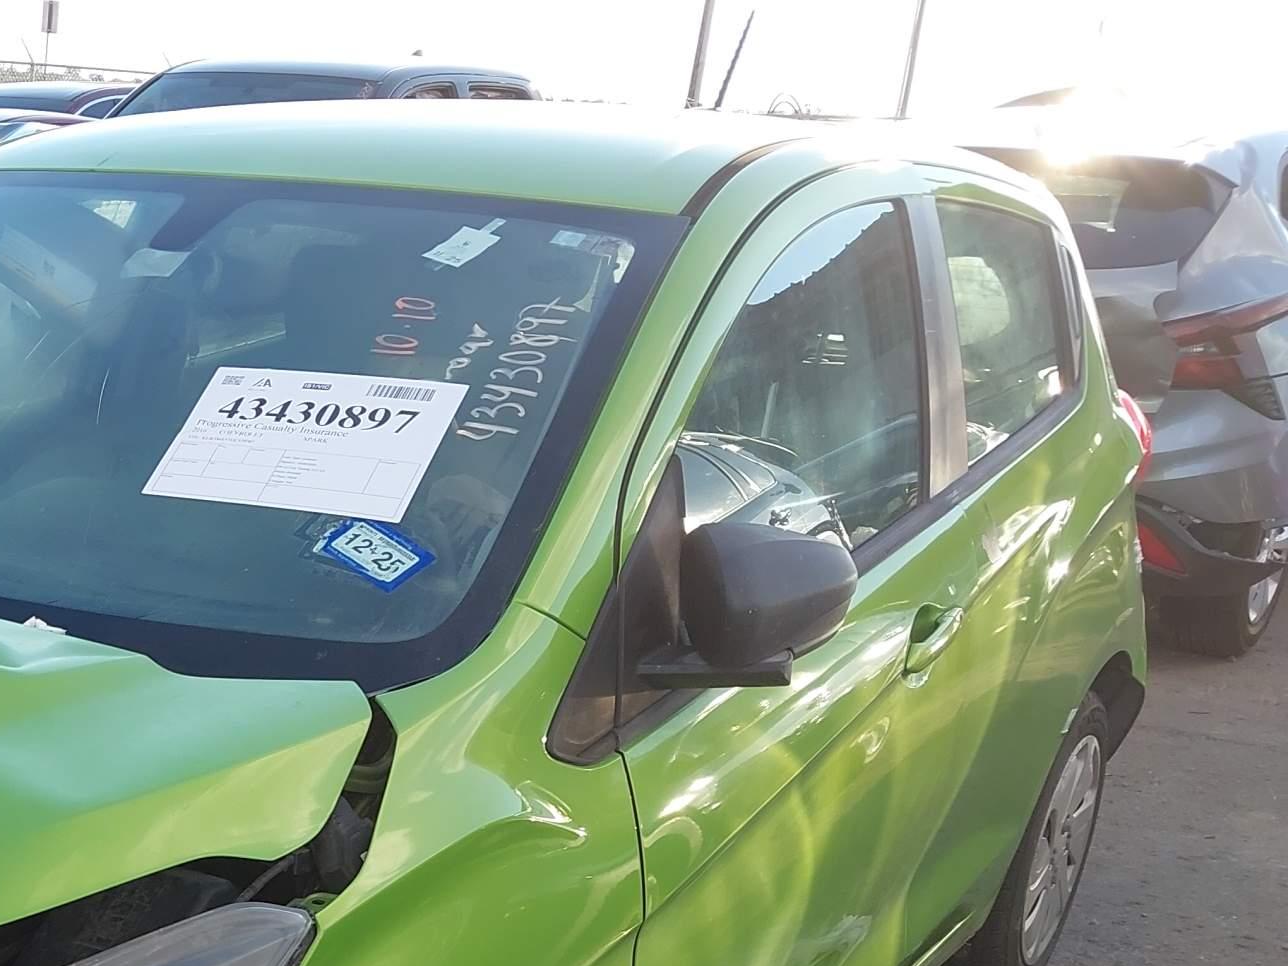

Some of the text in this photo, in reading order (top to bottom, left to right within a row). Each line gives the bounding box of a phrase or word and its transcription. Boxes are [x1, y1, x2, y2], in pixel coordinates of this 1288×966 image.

[196, 419, 350, 438] Progressive Casualty Insurance
[218, 396, 420, 434] 43430897
